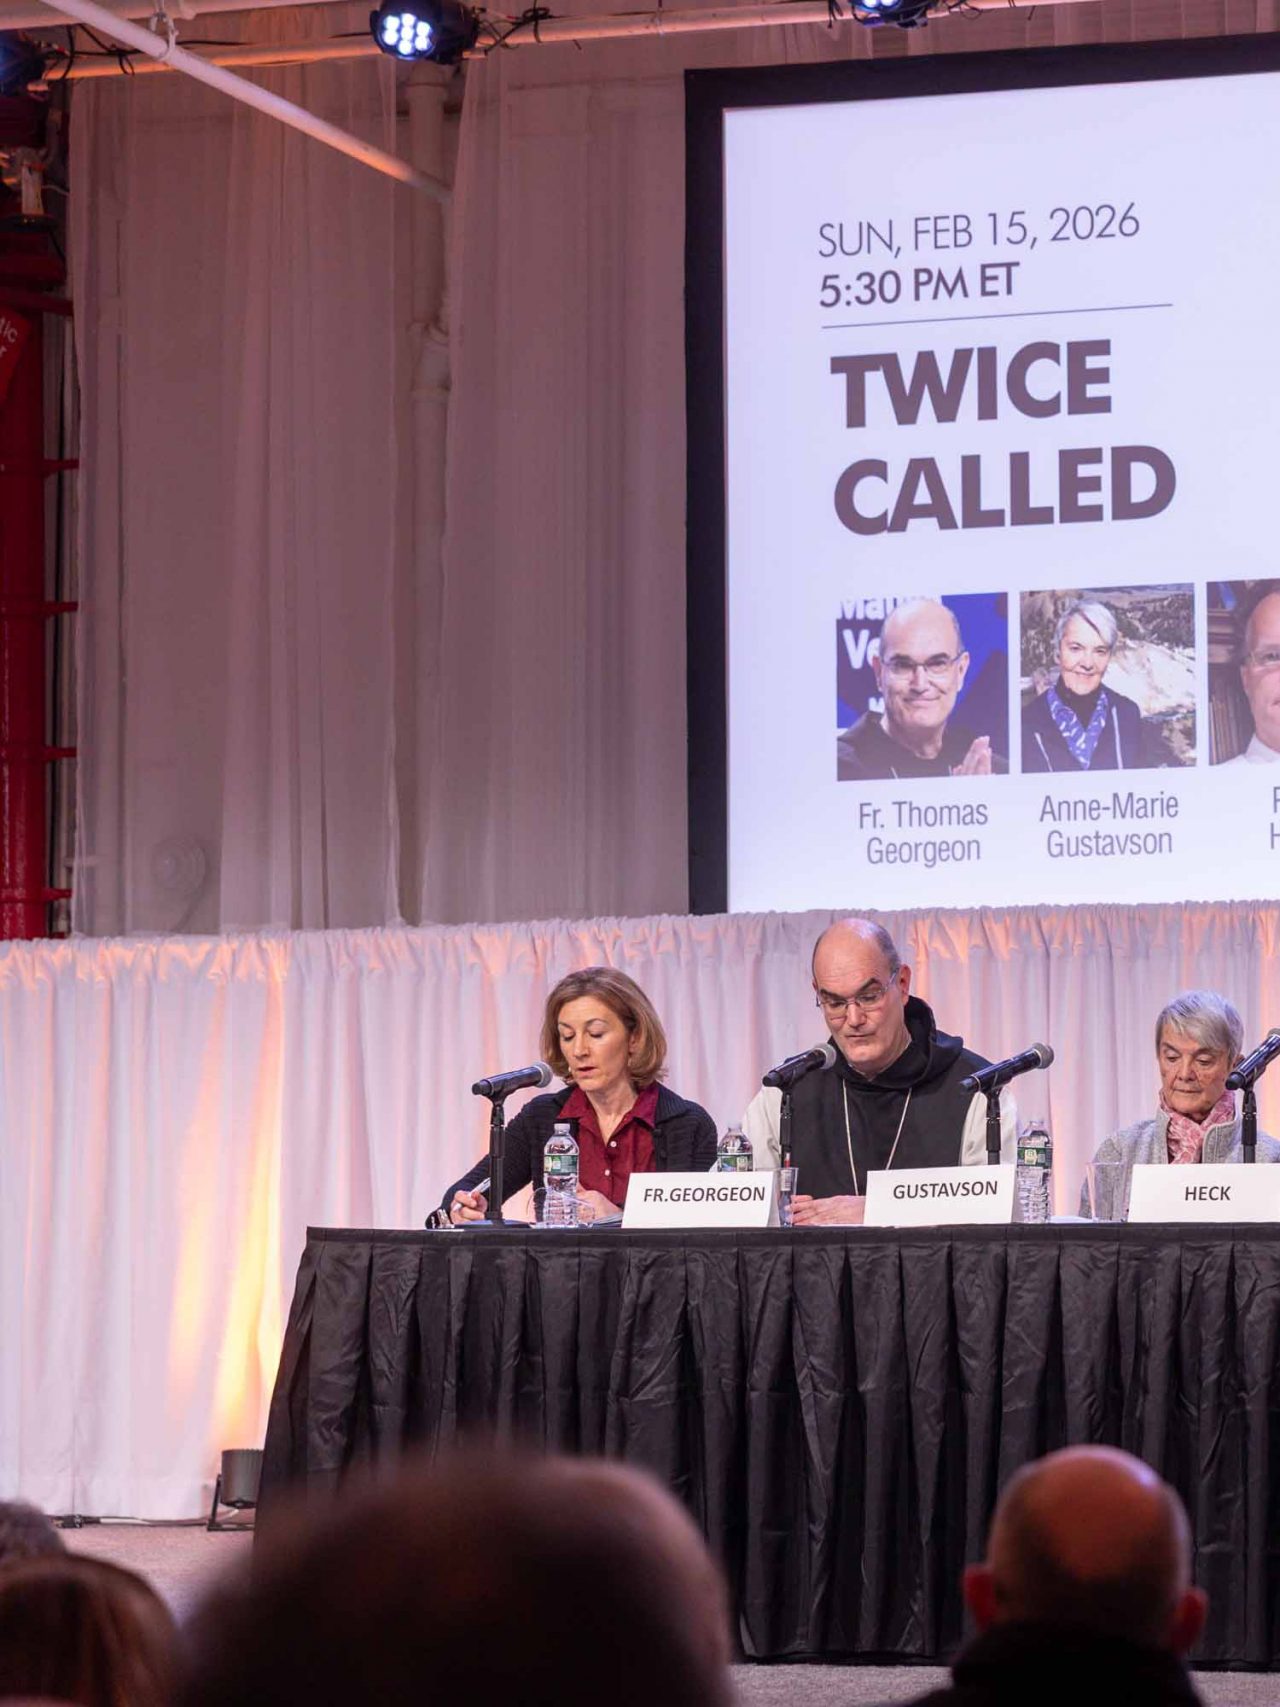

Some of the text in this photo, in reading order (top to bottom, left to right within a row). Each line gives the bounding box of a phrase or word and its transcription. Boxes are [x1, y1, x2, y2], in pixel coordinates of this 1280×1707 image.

[818, 202, 1140, 259] SUN, FEB 15, 2026
[819, 261, 1021, 308] 5:30 PM ET
[829, 338, 1112, 429] TWICE
[833, 444, 1177, 536] CALLED
[858, 801, 989, 830] Fr. Thomas
[1039, 791, 1179, 823] Anne-Marie
[866, 837, 981, 869] Georgeon
[1046, 829, 1173, 859] Gustavson
[643, 1186, 766, 1203] FR.GEORGEON
[893, 1180, 998, 1200] GUSTAVSON
[1185, 1186, 1231, 1201] HECK
